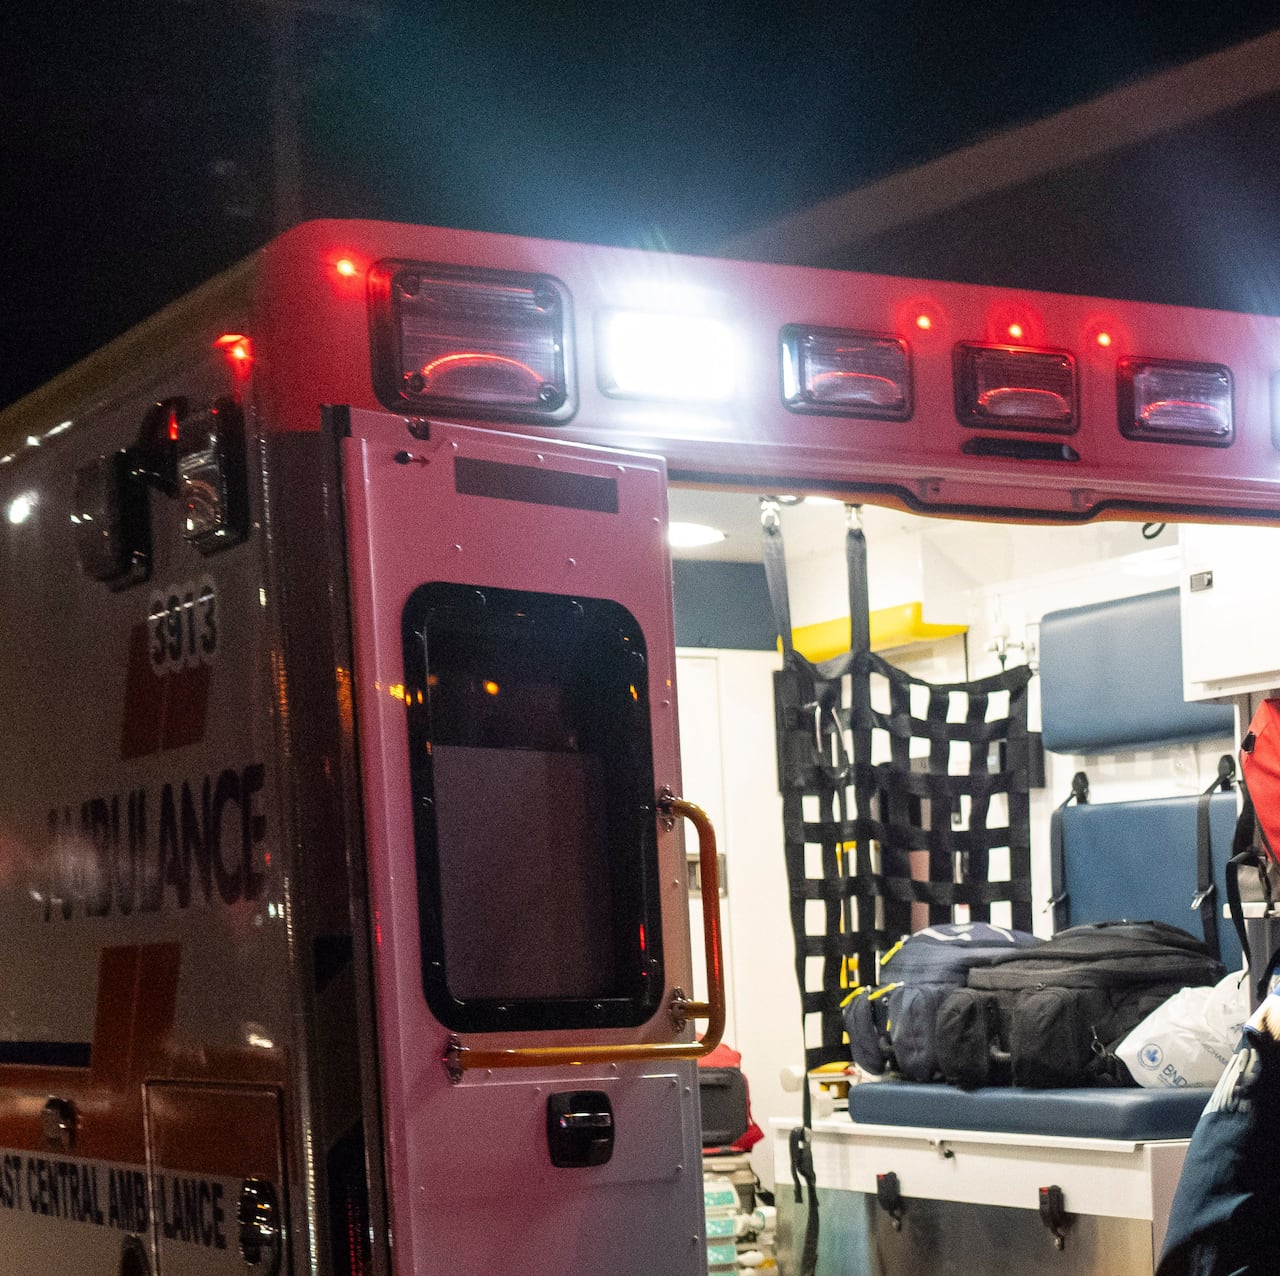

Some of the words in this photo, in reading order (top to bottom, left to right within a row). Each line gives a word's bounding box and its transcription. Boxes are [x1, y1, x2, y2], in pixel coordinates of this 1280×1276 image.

[150, 585, 217, 665] 3913
[43, 763, 267, 924] BULANCE
[0, 1155, 21, 1209] ST
[28, 1157, 104, 1225] CENTRAL
[108, 1167, 226, 1250] AMBLANCE
